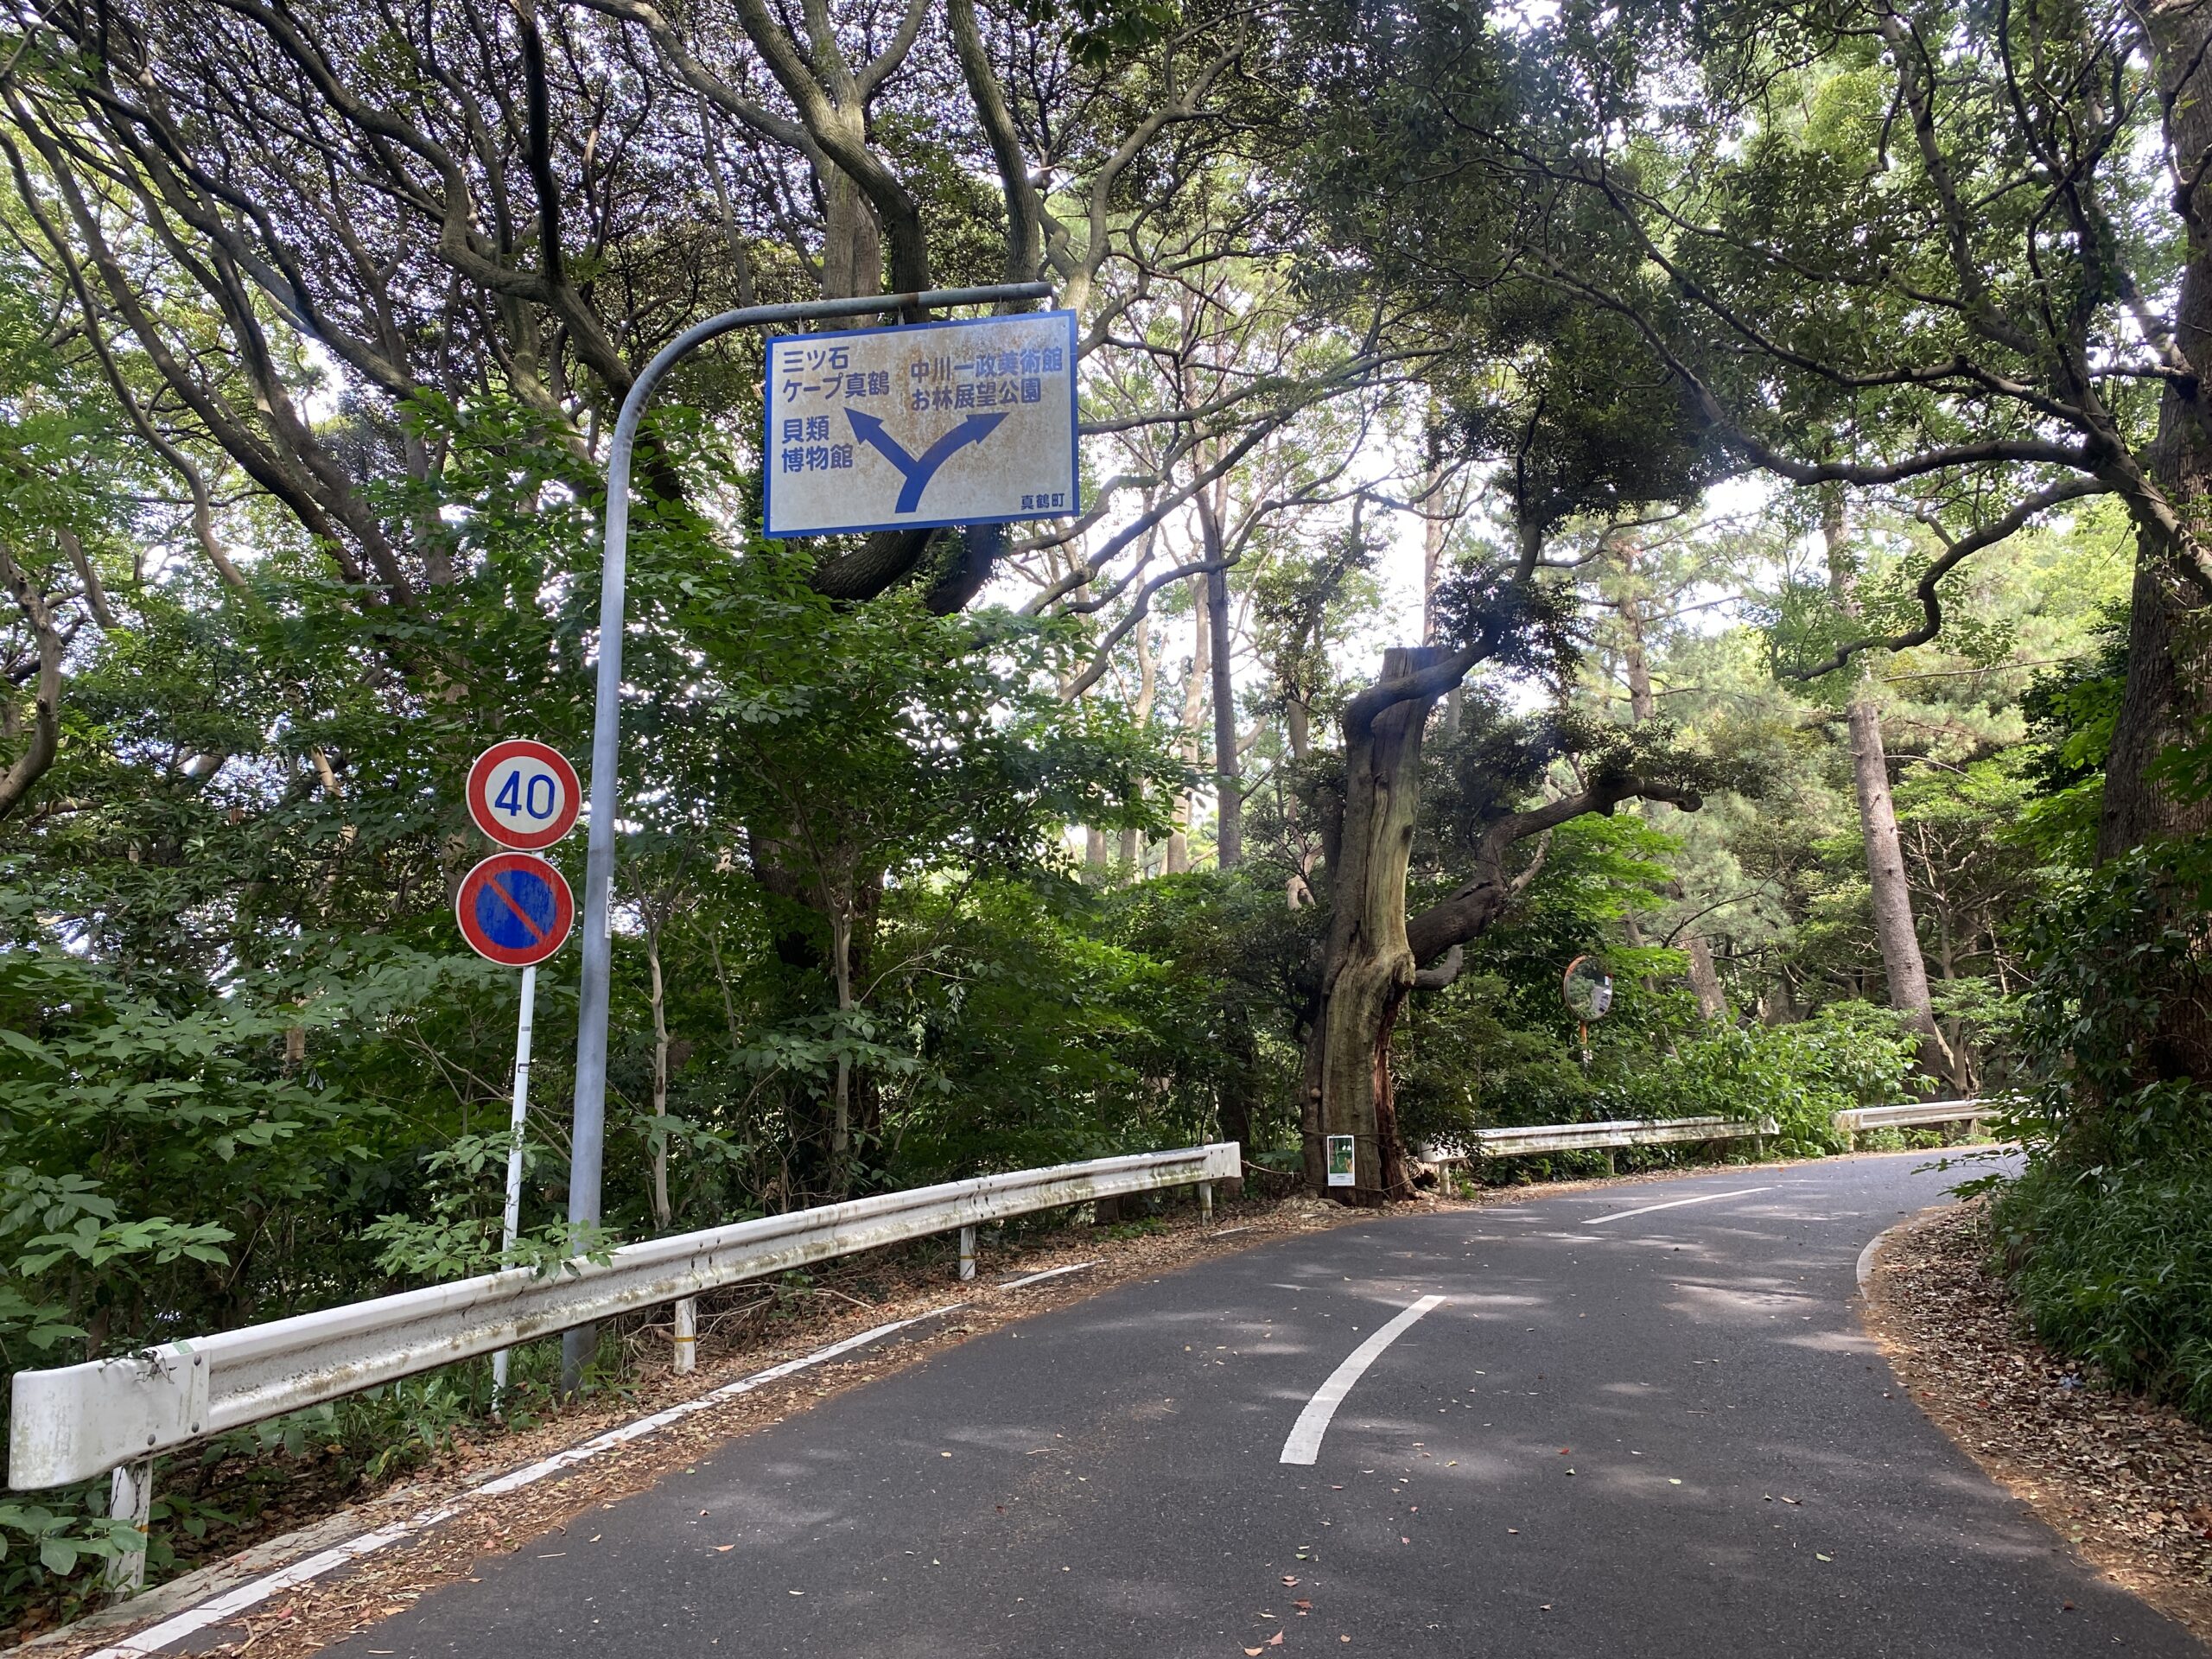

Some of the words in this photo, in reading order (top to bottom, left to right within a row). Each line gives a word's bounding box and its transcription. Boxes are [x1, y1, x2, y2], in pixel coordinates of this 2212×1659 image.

[783, 346, 849, 373] 三ツ石
[911, 346, 1063, 384] 中川一政美術館
[783, 370, 890, 403] ケープ真鶴
[911, 378, 1041, 411] お林展望公園
[782, 415, 830, 444] 貝類
[781, 443, 854, 474] 博物館
[1020, 493, 1065, 511] 真鶴町
[494, 770, 556, 820] 40
